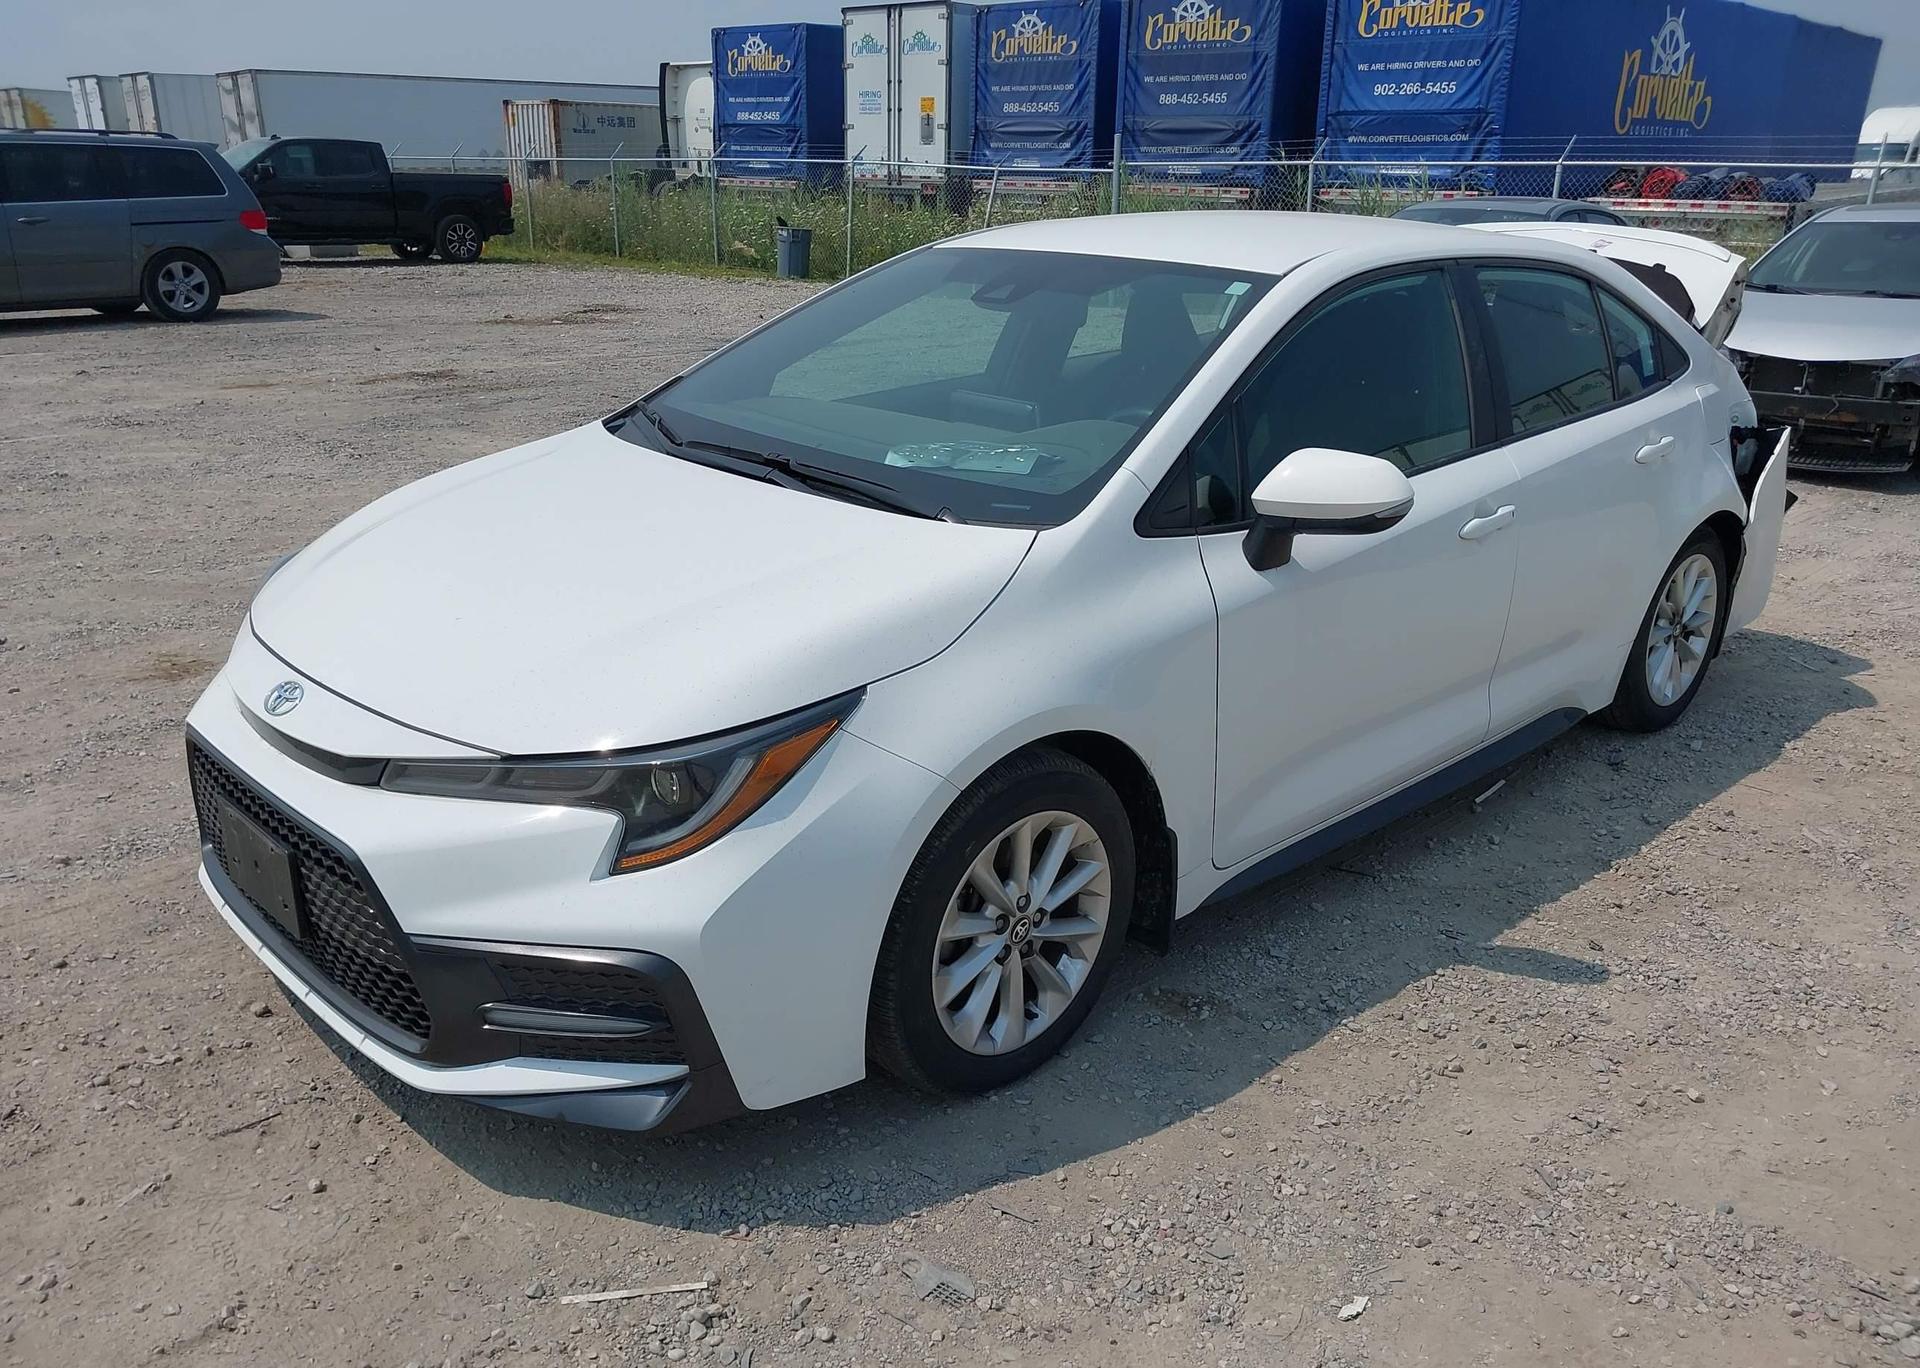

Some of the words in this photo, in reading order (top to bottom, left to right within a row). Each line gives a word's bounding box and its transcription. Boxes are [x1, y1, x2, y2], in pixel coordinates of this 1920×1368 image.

[1358, 0, 1484, 37] Corvette
[1145, 7, 1252, 50] Corvette
[990, 24, 1077, 62] Corvette
[728, 46, 790, 77] Corvette
[1357, 63, 1369, 71] WE
[1370, 63, 1385, 71] ARE
[1386, 61, 1413, 70] HIRING
[1413, 60, 1447, 69] DRIVERS
[1448, 59, 1466, 67] AND
[1155, 75, 1168, 83] ARE
[858, 90, 882, 99] HIRING
[1373, 82, 1457, 95] 902-266-5455
[1615, 48, 1712, 134] Corvette
[1159, 92, 1228, 104] 888-452-5455
[1003, 102, 1060, 112] 888-452-5455
